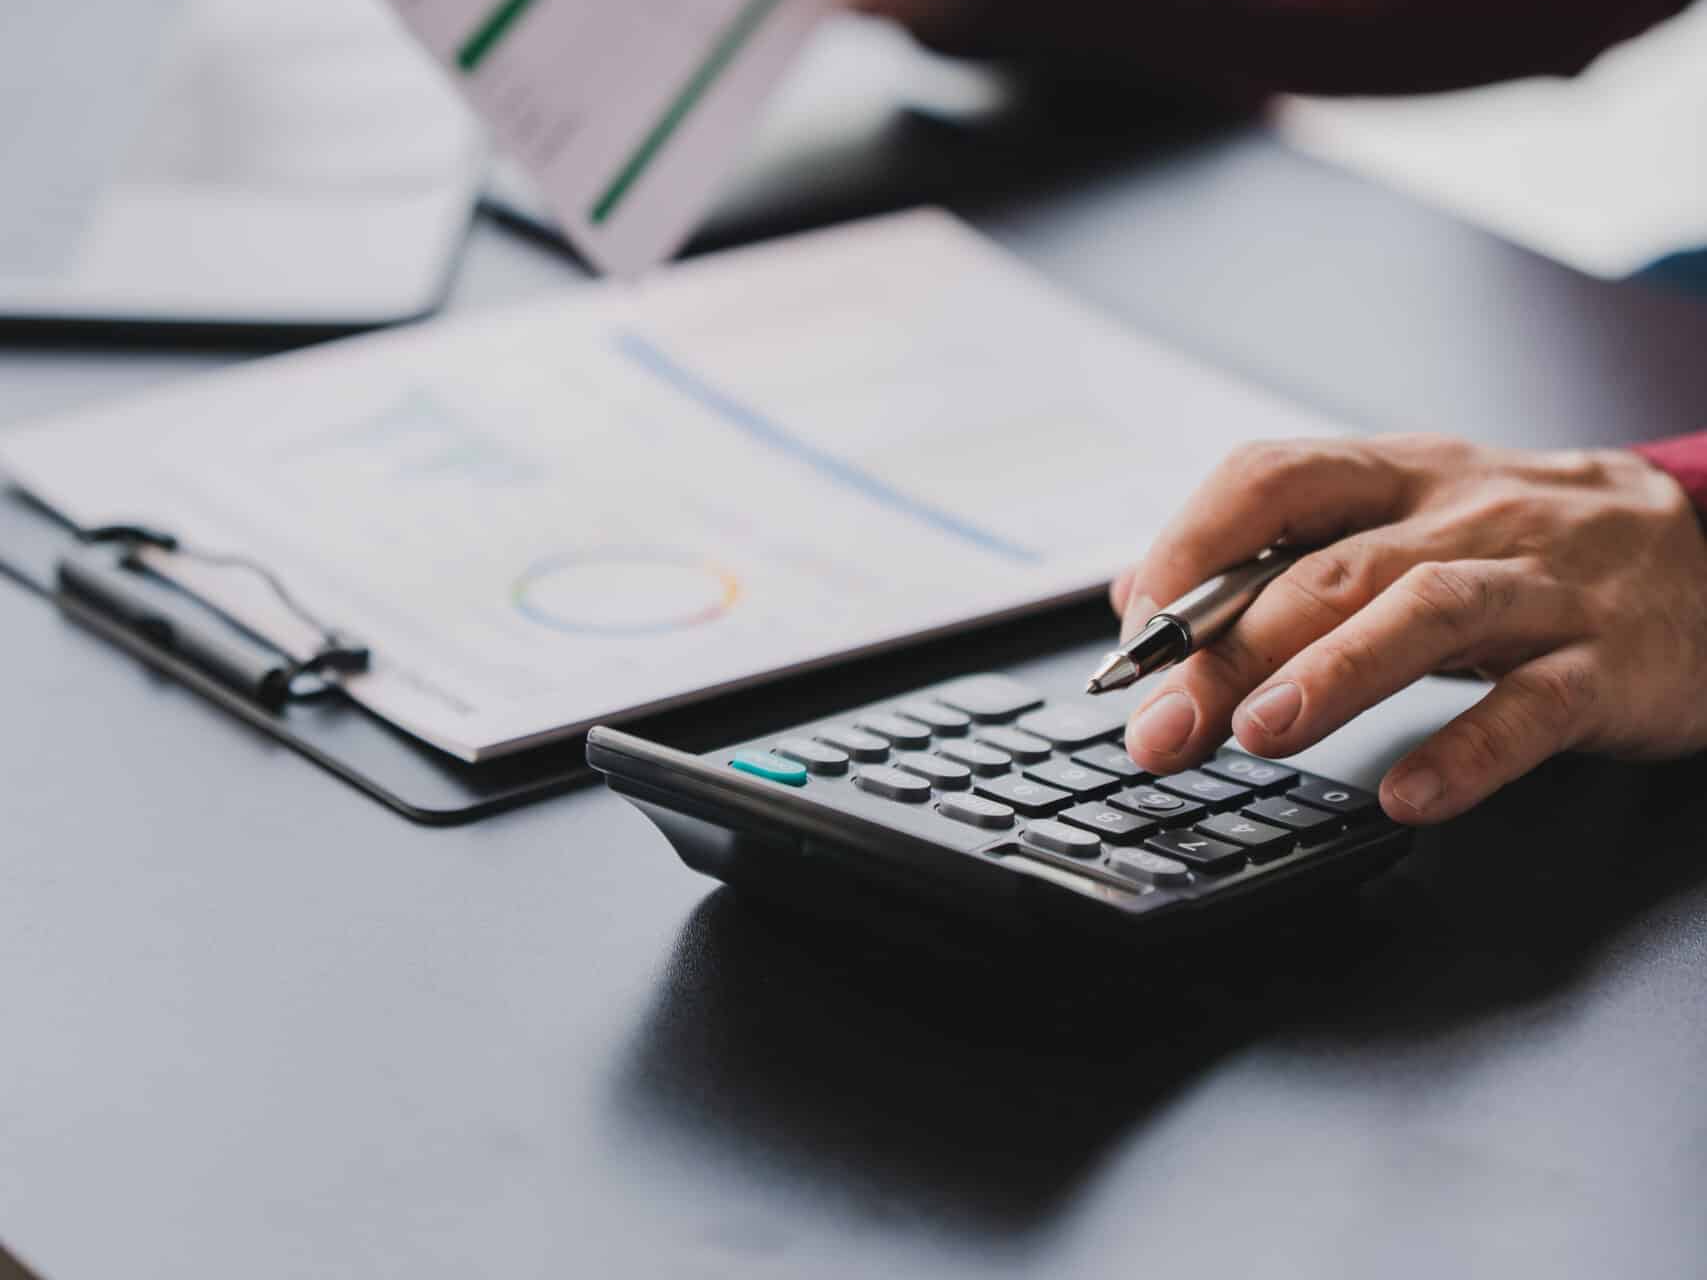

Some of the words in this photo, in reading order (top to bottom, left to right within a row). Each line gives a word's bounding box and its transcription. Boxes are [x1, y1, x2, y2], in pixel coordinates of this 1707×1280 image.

[1141, 792, 1171, 806] 5
[1322, 791, 1351, 803] 0
[1096, 812, 1124, 823] 8
[1279, 807, 1300, 817] 1
[1231, 823, 1257, 834] 4
[1177, 840, 1209, 852] 7
